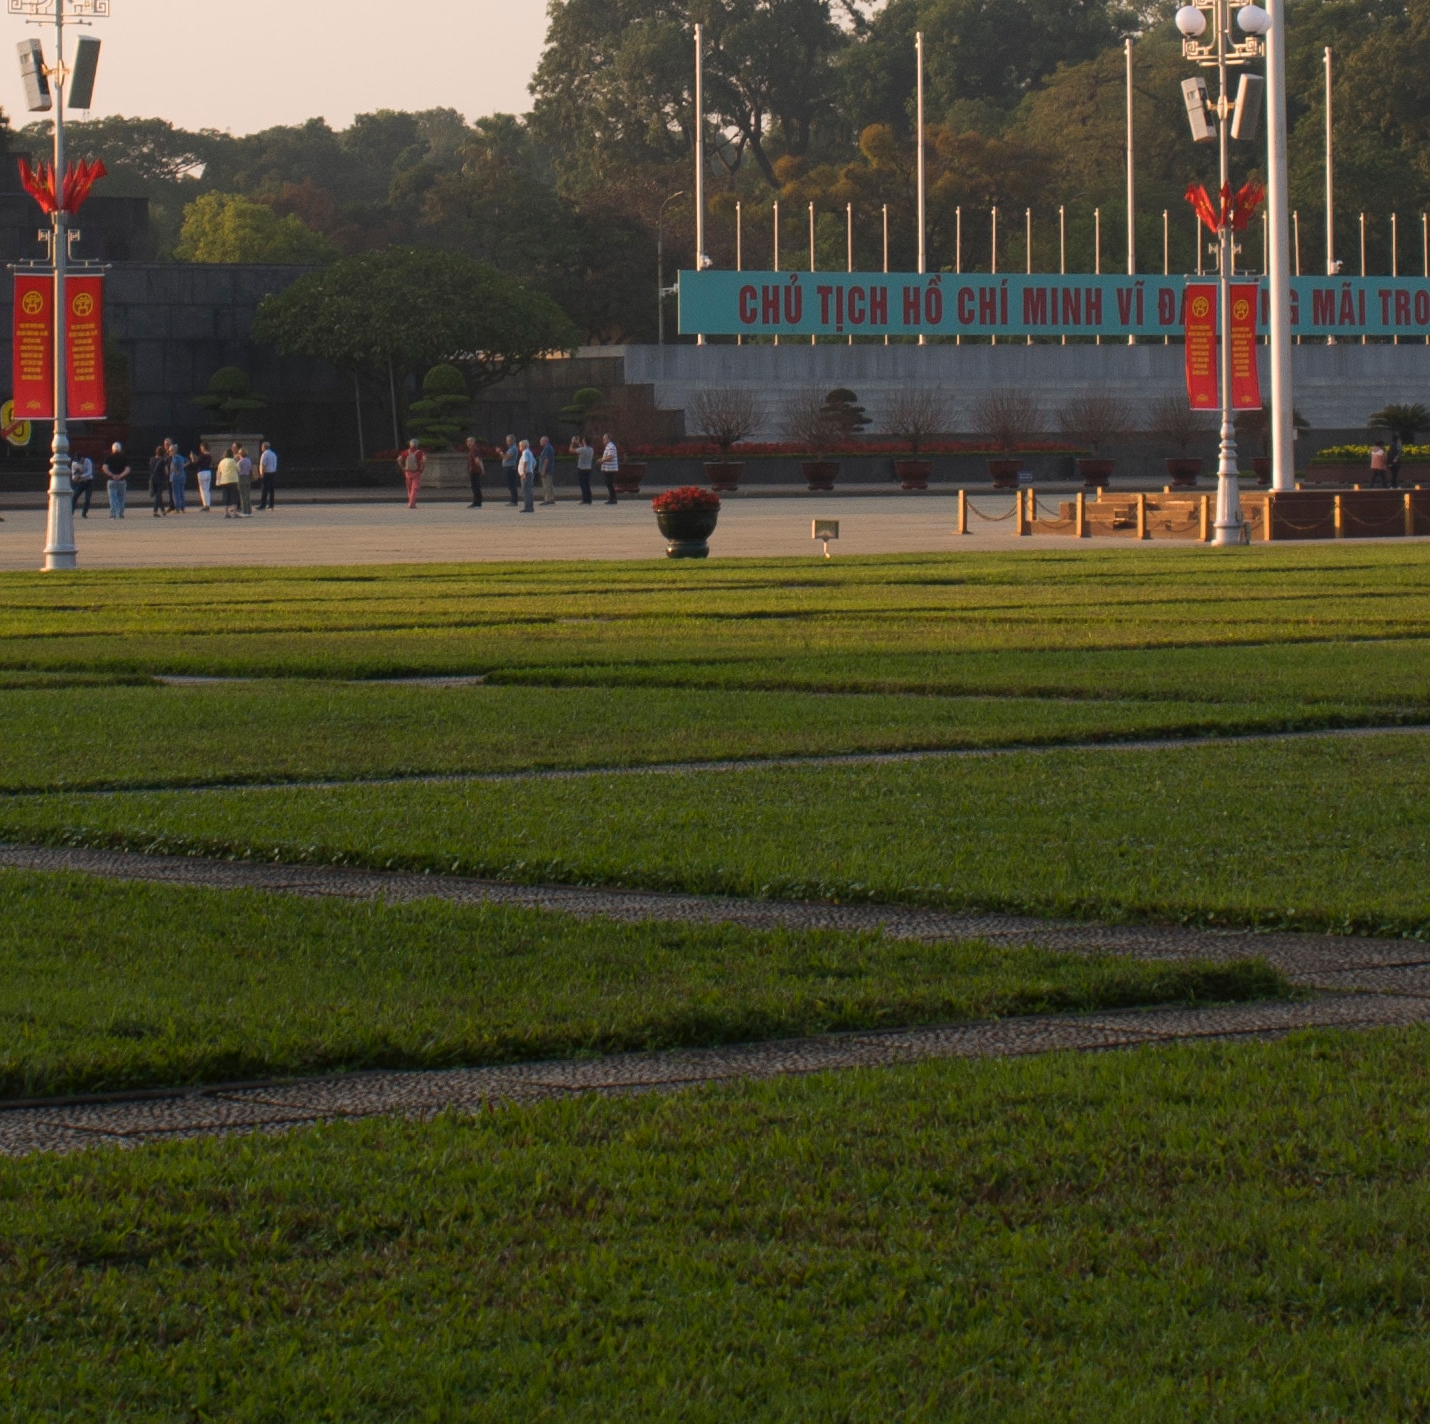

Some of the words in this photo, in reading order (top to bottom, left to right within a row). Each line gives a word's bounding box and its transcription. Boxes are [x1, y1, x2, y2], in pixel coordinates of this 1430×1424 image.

[739, 274, 802, 325] CHỦ
[817, 285, 888, 332] TỊCH
[903, 274, 942, 325] HỒ
[958, 279, 1009, 326] CHÍ
[1023, 287, 1103, 326] MINH
[1116, 281, 1145, 326] VĨ
[1312, 281, 1365, 326] MÃI
